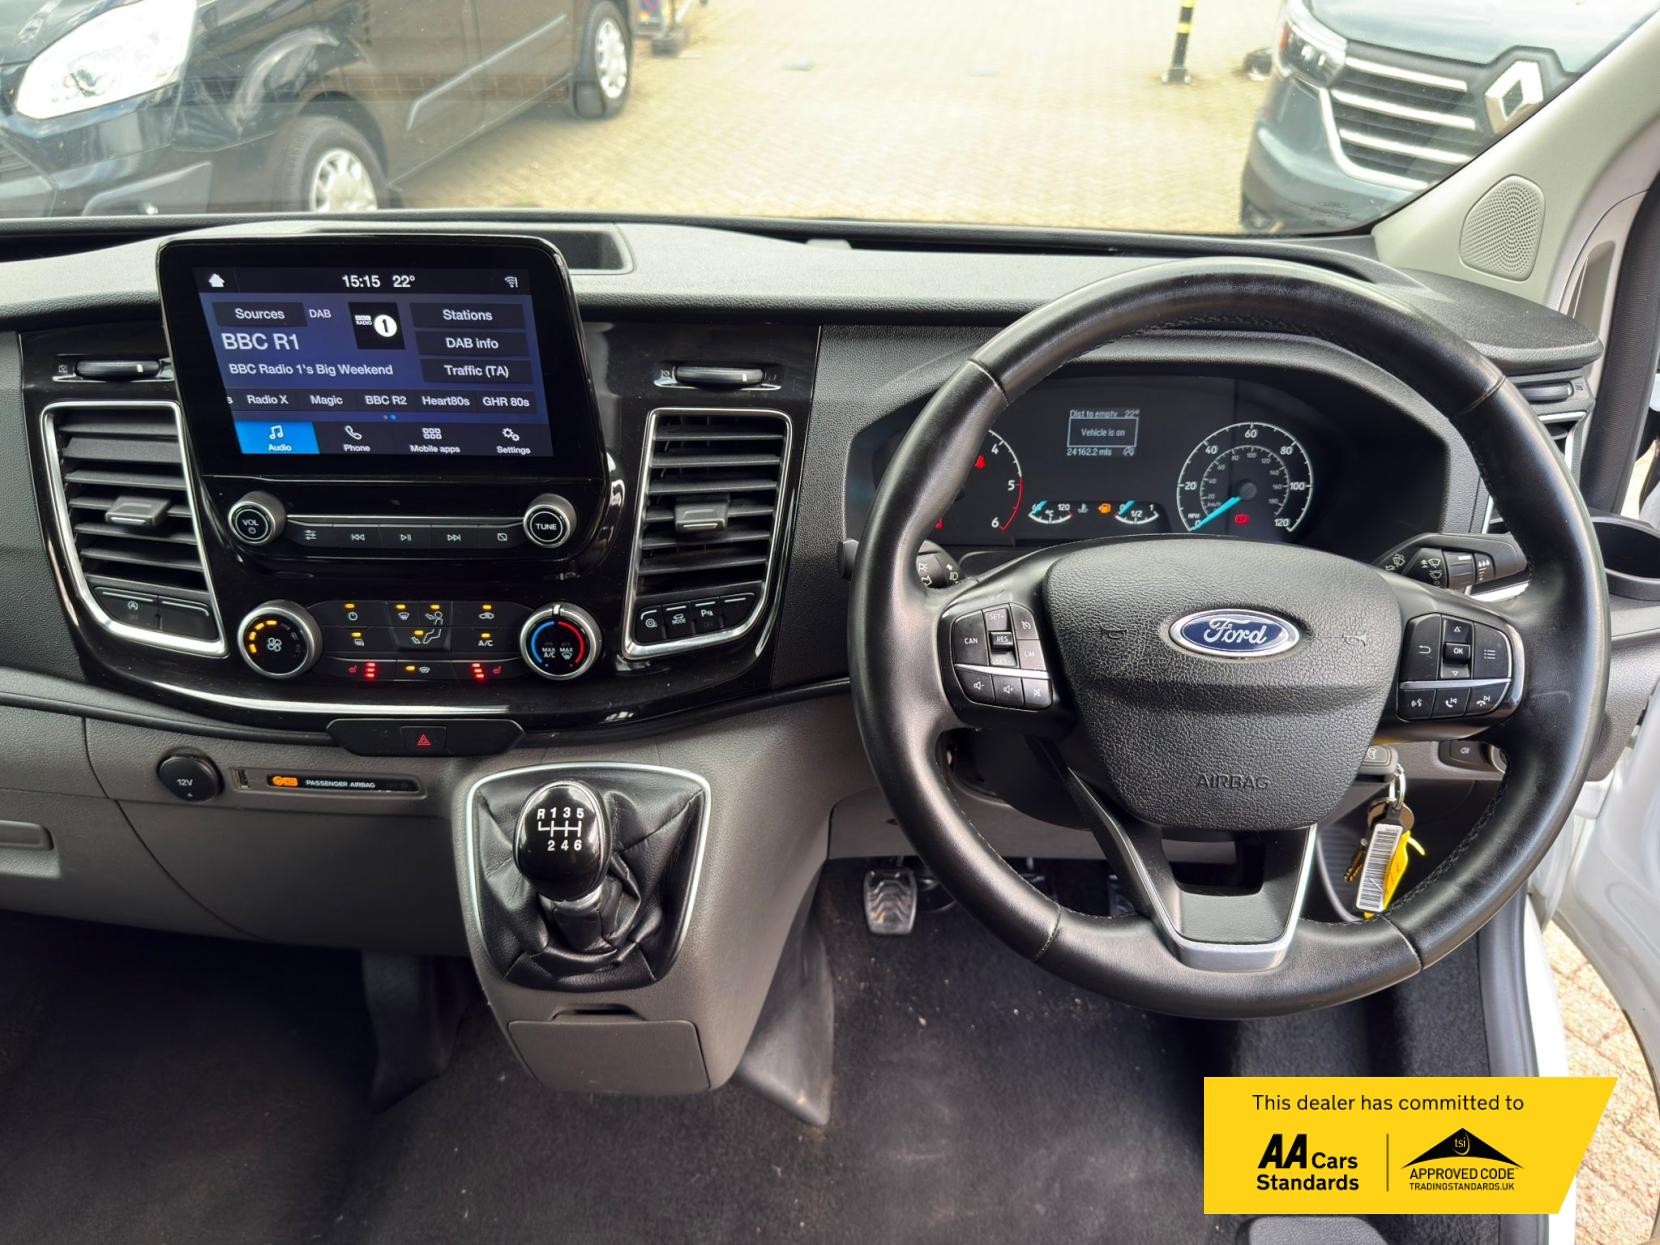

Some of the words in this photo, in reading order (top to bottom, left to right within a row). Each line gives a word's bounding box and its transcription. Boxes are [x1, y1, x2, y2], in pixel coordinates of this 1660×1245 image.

[342, 275, 381, 288] 15:15
[392, 275, 416, 288] 22°
[235, 308, 285, 320] Sources
[309, 309, 332, 318] DAB
[443, 310, 493, 321] Stations
[222, 333, 268, 350] BBC
[273, 334, 300, 350] R1
[446, 338, 473, 348] DAB
[476, 338, 499, 349] info
[229, 364, 256, 374] BBC
[260, 364, 293, 375] Radio
[296, 364, 314, 375] 1's
[316, 364, 336, 377] Big
[338, 364, 393, 376] Weekend
[444, 365, 482, 376] Traffic
[485, 365, 509, 378] (TA)
[247, 395, 278, 404] Radio
[279, 395, 288, 404] X
[310, 395, 343, 406] Magic
[365, 396, 390, 405] BBC
[391, 396, 407, 405] R2
[422, 396, 470, 406] Heart80s
[482, 397, 507, 407] GHR
[508, 397, 530, 407] 80s
[1081, 428, 1107, 436] Vehicle
[1108, 428, 1115, 436] is
[1244, 430, 1258, 438] 60
[344, 444, 370, 452] Phone
[410, 444, 437, 452] Mobile
[438, 446, 460, 454] apps
[496, 446, 531, 455] Settings
[991, 444, 999, 454] 4
[1205, 445, 1218, 454] 40
[1280, 446, 1293, 456] 80
[1008, 480, 1015, 490] 5
[1184, 482, 1197, 490] 20
[1290, 482, 1305, 490] 100
[242, 519, 260, 527] VOL
[536, 523, 558, 531] TUNE
[991, 517, 1000, 528] 6
[1274, 518, 1290, 527] 120
[1203, 618, 1268, 644] Ford
[478, 639, 493, 647] A/C
[177, 778, 193, 786] 12V
[306, 779, 348, 788] PASSENGER
[1198, 774, 1270, 790] AIRBAG
[536, 808, 546, 820] R
[550, 806, 557, 818] 1
[563, 806, 571, 818] 3
[576, 808, 584, 818] 5
[548, 840, 556, 851] 2
[560, 840, 569, 851] 4
[574, 840, 582, 851] 6
